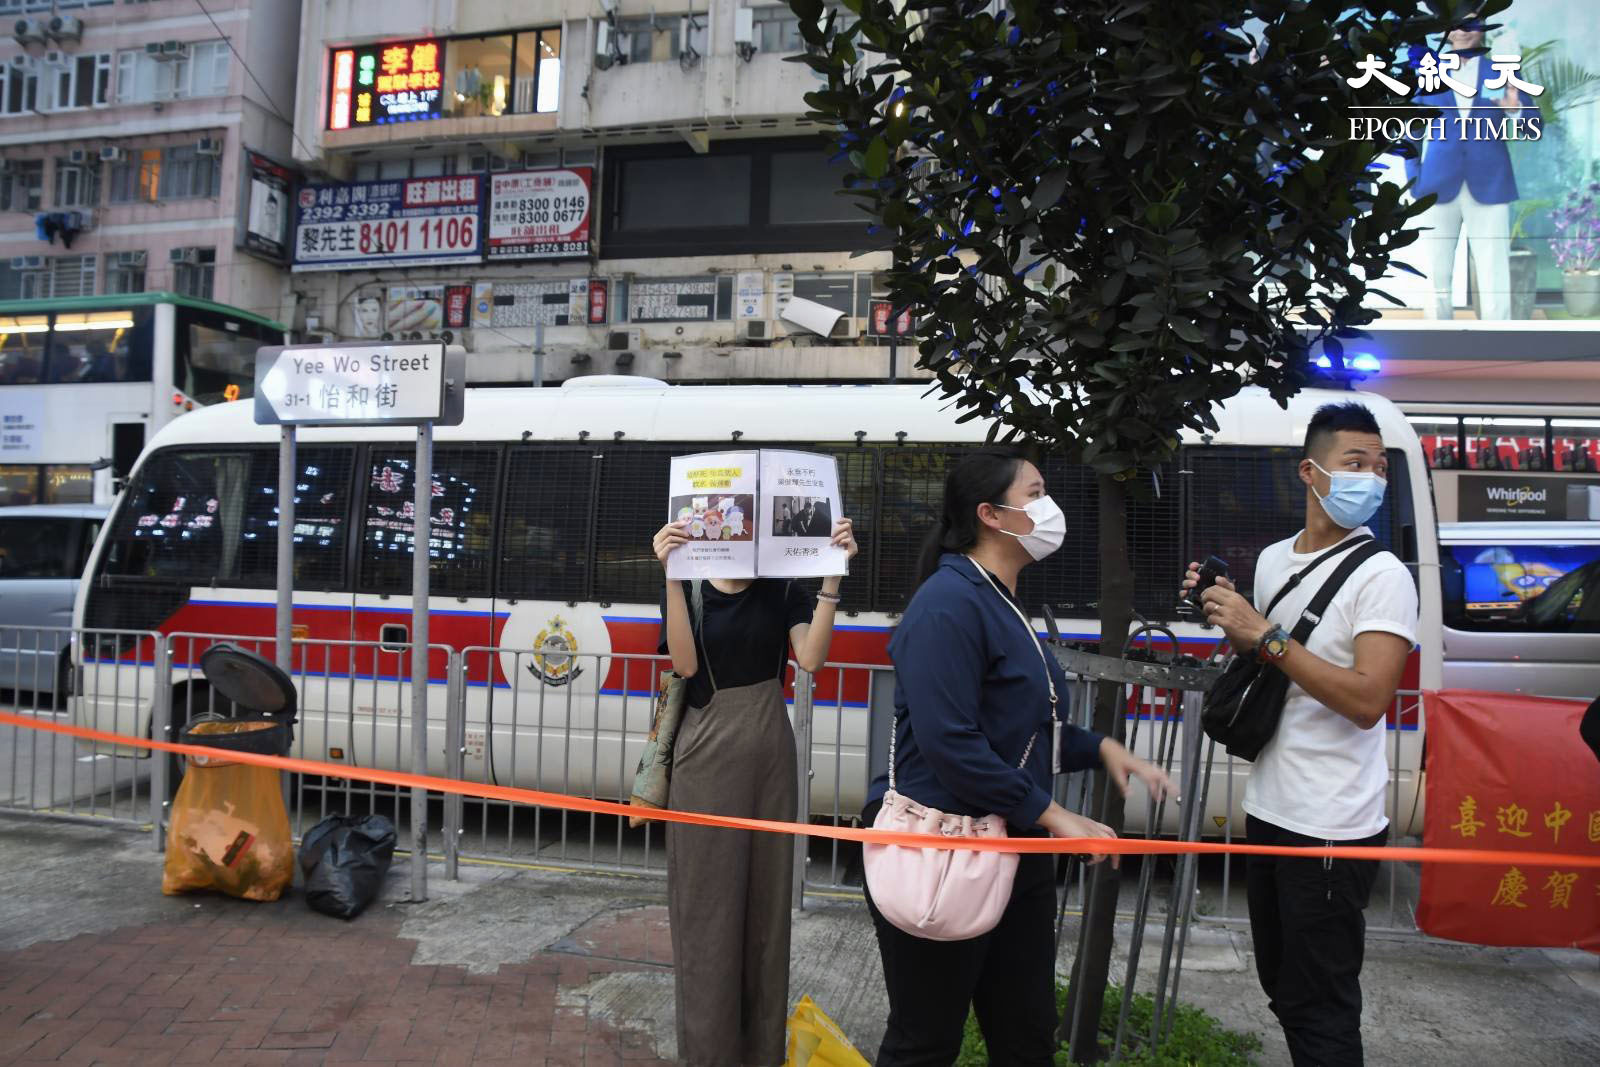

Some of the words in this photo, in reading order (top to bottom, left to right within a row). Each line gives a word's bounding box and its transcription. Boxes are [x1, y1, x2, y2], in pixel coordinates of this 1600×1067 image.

[302, 206, 343, 220] 2392
[345, 202, 390, 218] 3392
[519, 198, 549, 211] 8300
[554, 196, 584, 209] 0146
[519, 211, 549, 224] 8300
[553, 209, 584, 222] 0677
[302, 224, 355, 252] 黎先生
[359, 220, 409, 254] 8101
[420, 216, 473, 250] 1106
[293, 357, 324, 375] Yee
[333, 356, 360, 373] Wo
[370, 353, 430, 372] Street
[284, 393, 310, 407] 31-1
[319, 383, 397, 409] 怡和街
[1486, 487, 1547, 504] Whirlpool
[784, 546, 819, 557] 天佑香港
